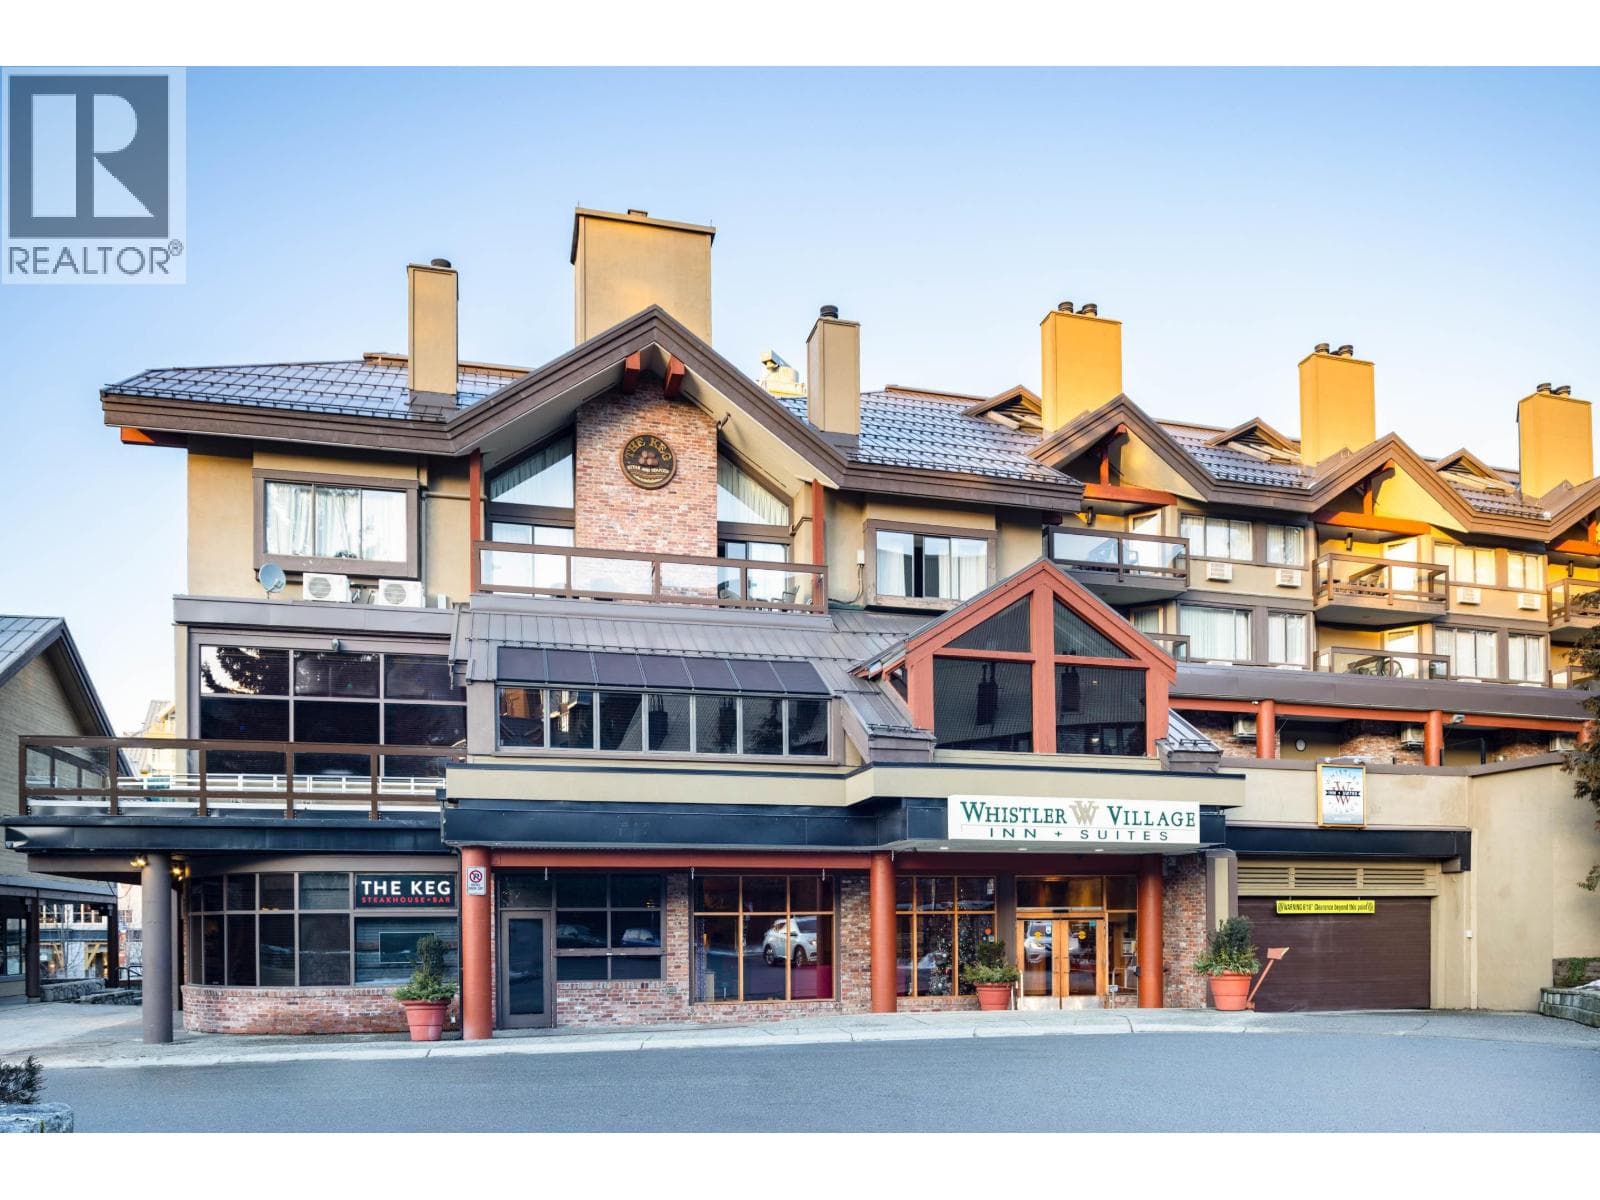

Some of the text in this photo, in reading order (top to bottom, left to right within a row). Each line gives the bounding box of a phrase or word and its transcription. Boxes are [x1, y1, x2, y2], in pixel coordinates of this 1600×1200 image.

[625, 437, 672, 461] THE KEG
[960, 801, 1067, 824] WHISTLER
[1107, 805, 1195, 827] VILLAGE
[990, 827, 1037, 838] INN
[1080, 829, 1169, 841] SUITES
[361, 880, 451, 896] THE KEG
